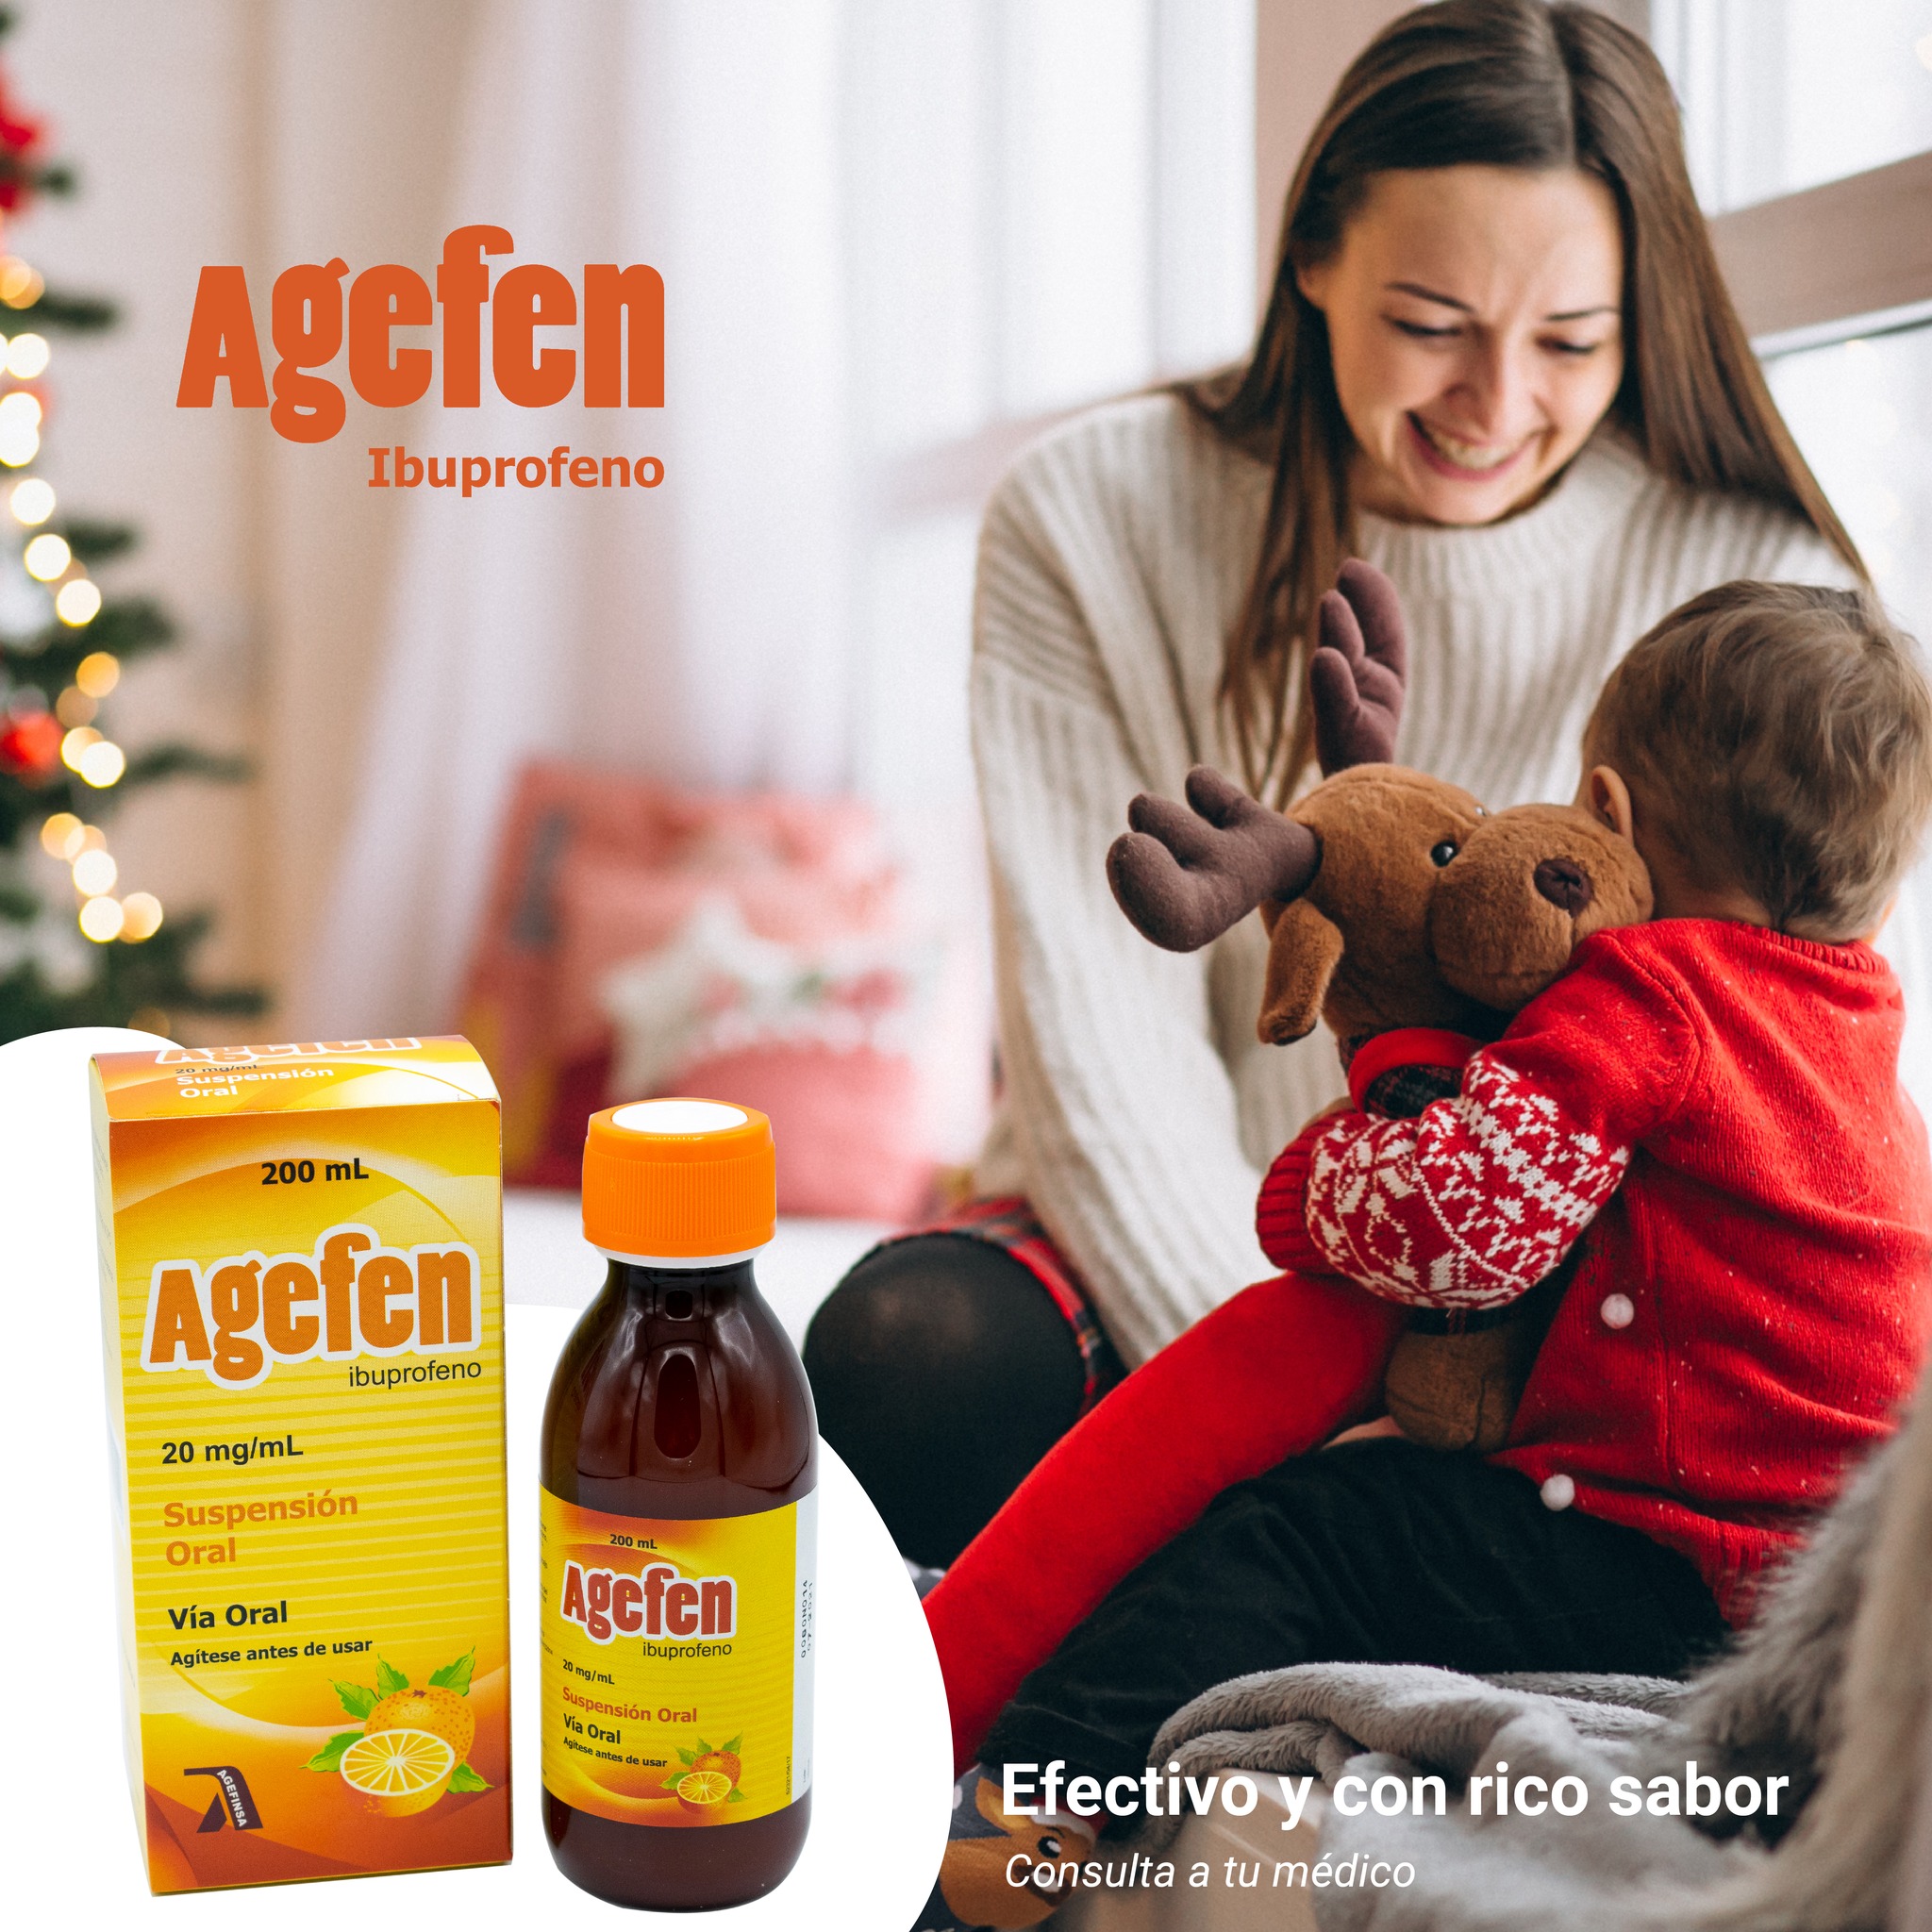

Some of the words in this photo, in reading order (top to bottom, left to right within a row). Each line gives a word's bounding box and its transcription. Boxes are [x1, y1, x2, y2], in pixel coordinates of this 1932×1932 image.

[176, 1066, 334, 1086] Suspensión
[202, 1064, 263, 1074] mg/mL
[179, 1085, 238, 1098] Oral
[261, 1160, 315, 1185] 200
[325, 1158, 369, 1181] mL
[148, 1232, 473, 1381] Agefen
[348, 1358, 481, 1390] ibuprofeno
[161, 1441, 194, 1464] 20
[205, 1435, 304, 1466] mg/mL
[163, 1489, 358, 1530] Suspensión
[165, 1537, 236, 1567] Oral
[609, 1533, 634, 1547] 200
[637, 1538, 658, 1550] mL
[168, 1605, 216, 1630] Vía
[225, 1600, 288, 1626] Oral
[562, 1564, 732, 1641] Agefen
[171, 1649, 242, 1669] Agítese
[246, 1645, 299, 1661] antes
[304, 1641, 326, 1657] de
[332, 1640, 373, 1655] usar
[642, 1641, 733, 1661] ibuprofeno
[562, 1658, 574, 1673] 20
[575, 1665, 616, 1686] mg/mL
[562, 1686, 652, 1722] Suspensión
[657, 1707, 697, 1724] Oral
[563, 1712, 584, 1735] Vía
[587, 1723, 621, 1744] Oral
[563, 1736, 594, 1757] Agítese
[594, 1750, 624, 1763] antes
[625, 1755, 640, 1766] de
[641, 1757, 668, 1768] usar
[216, 1769, 248, 1828] AGEFINSA
